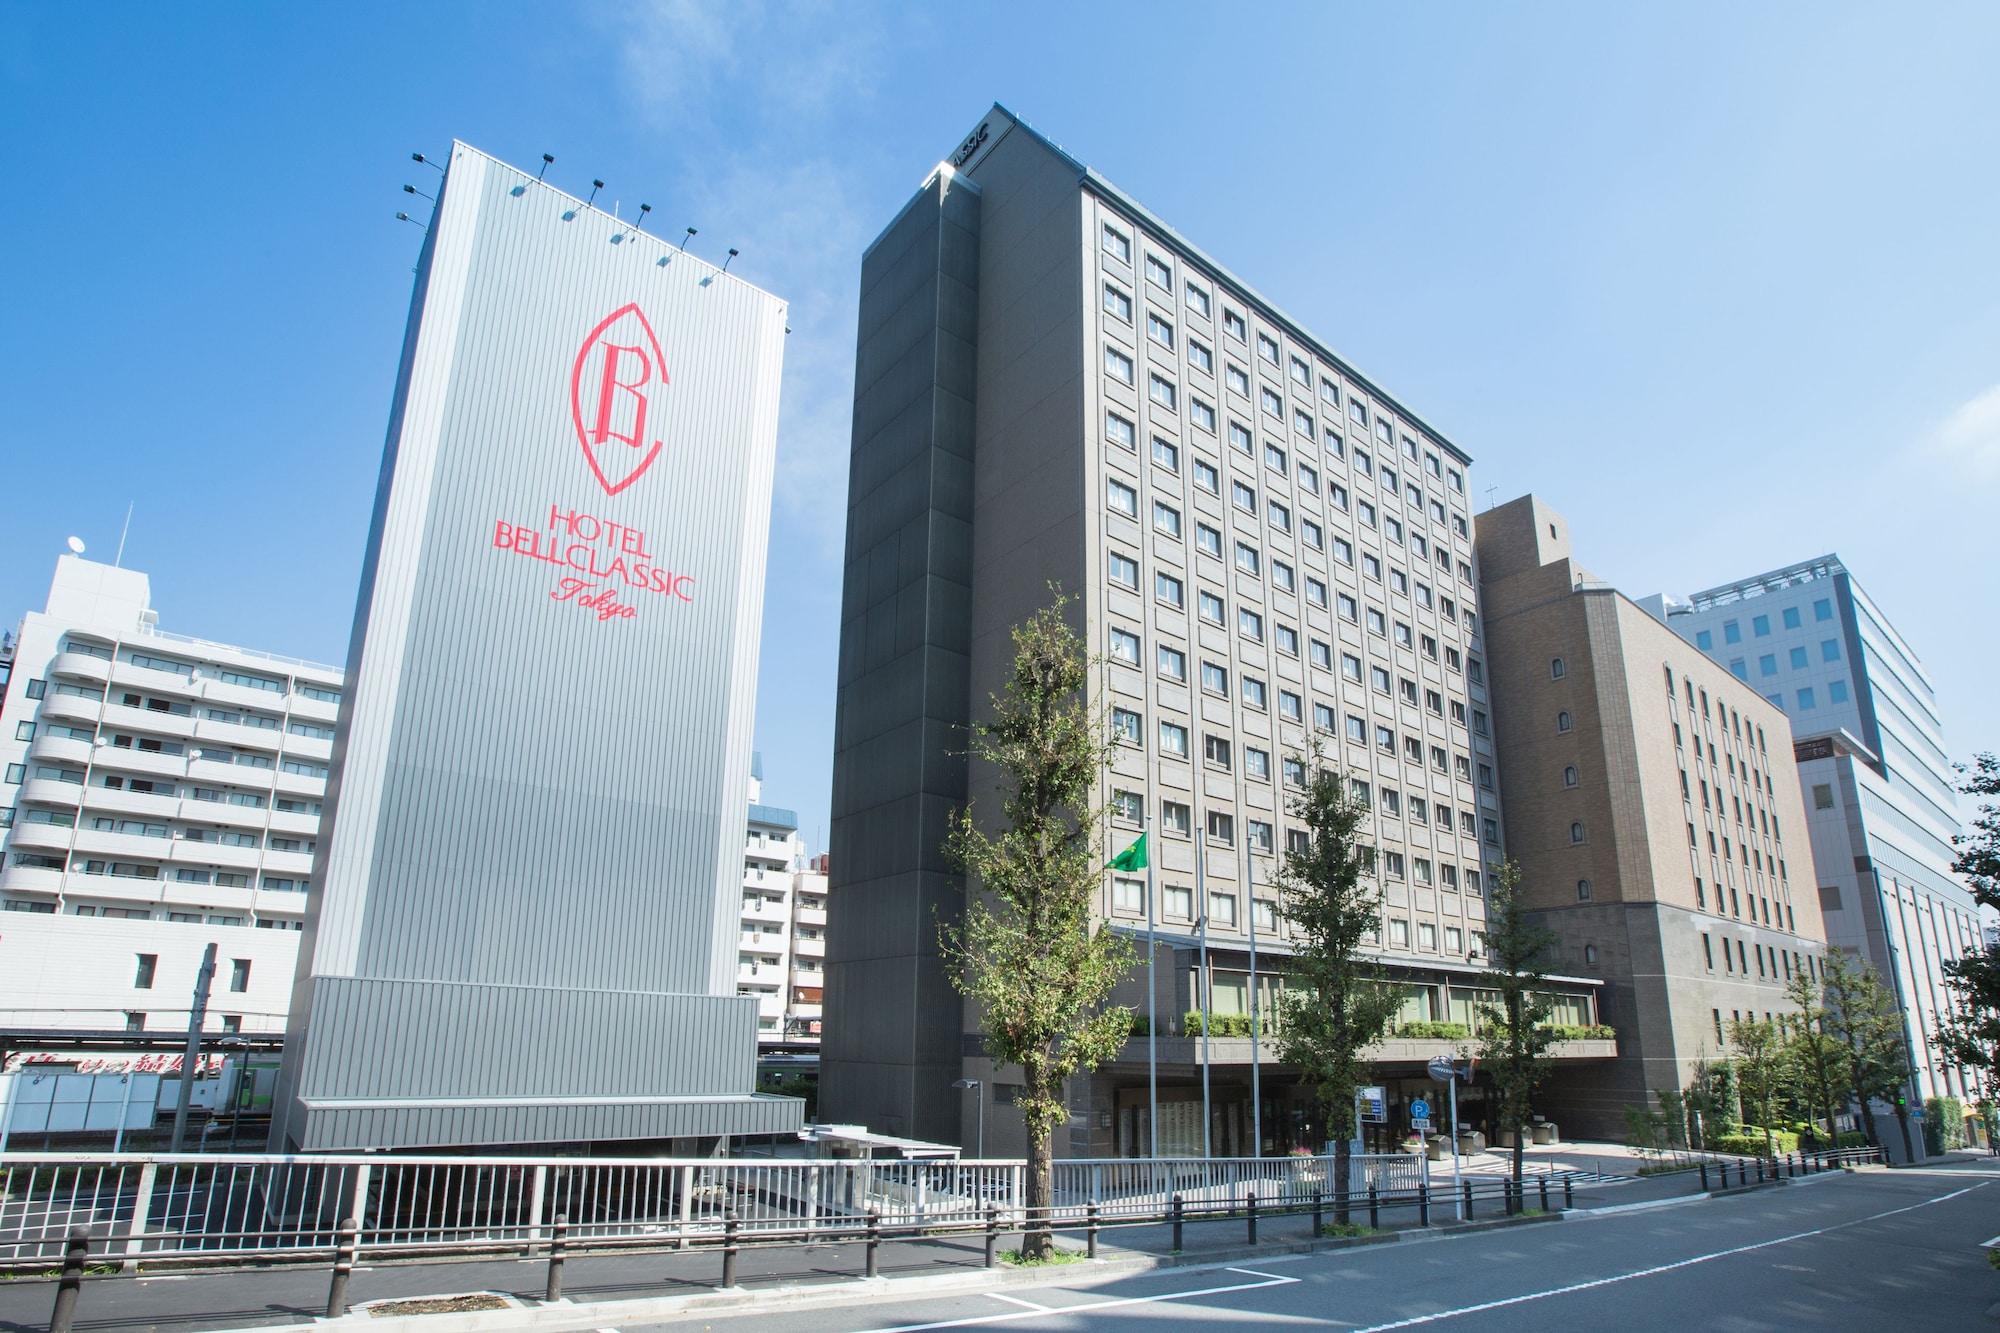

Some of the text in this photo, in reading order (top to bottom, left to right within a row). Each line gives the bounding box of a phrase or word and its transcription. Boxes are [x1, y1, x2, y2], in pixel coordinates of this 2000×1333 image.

[549, 503, 654, 560] HOTEL
[493, 518, 697, 603] BELLCLASSIC
[550, 576, 638, 622] Tokyo
